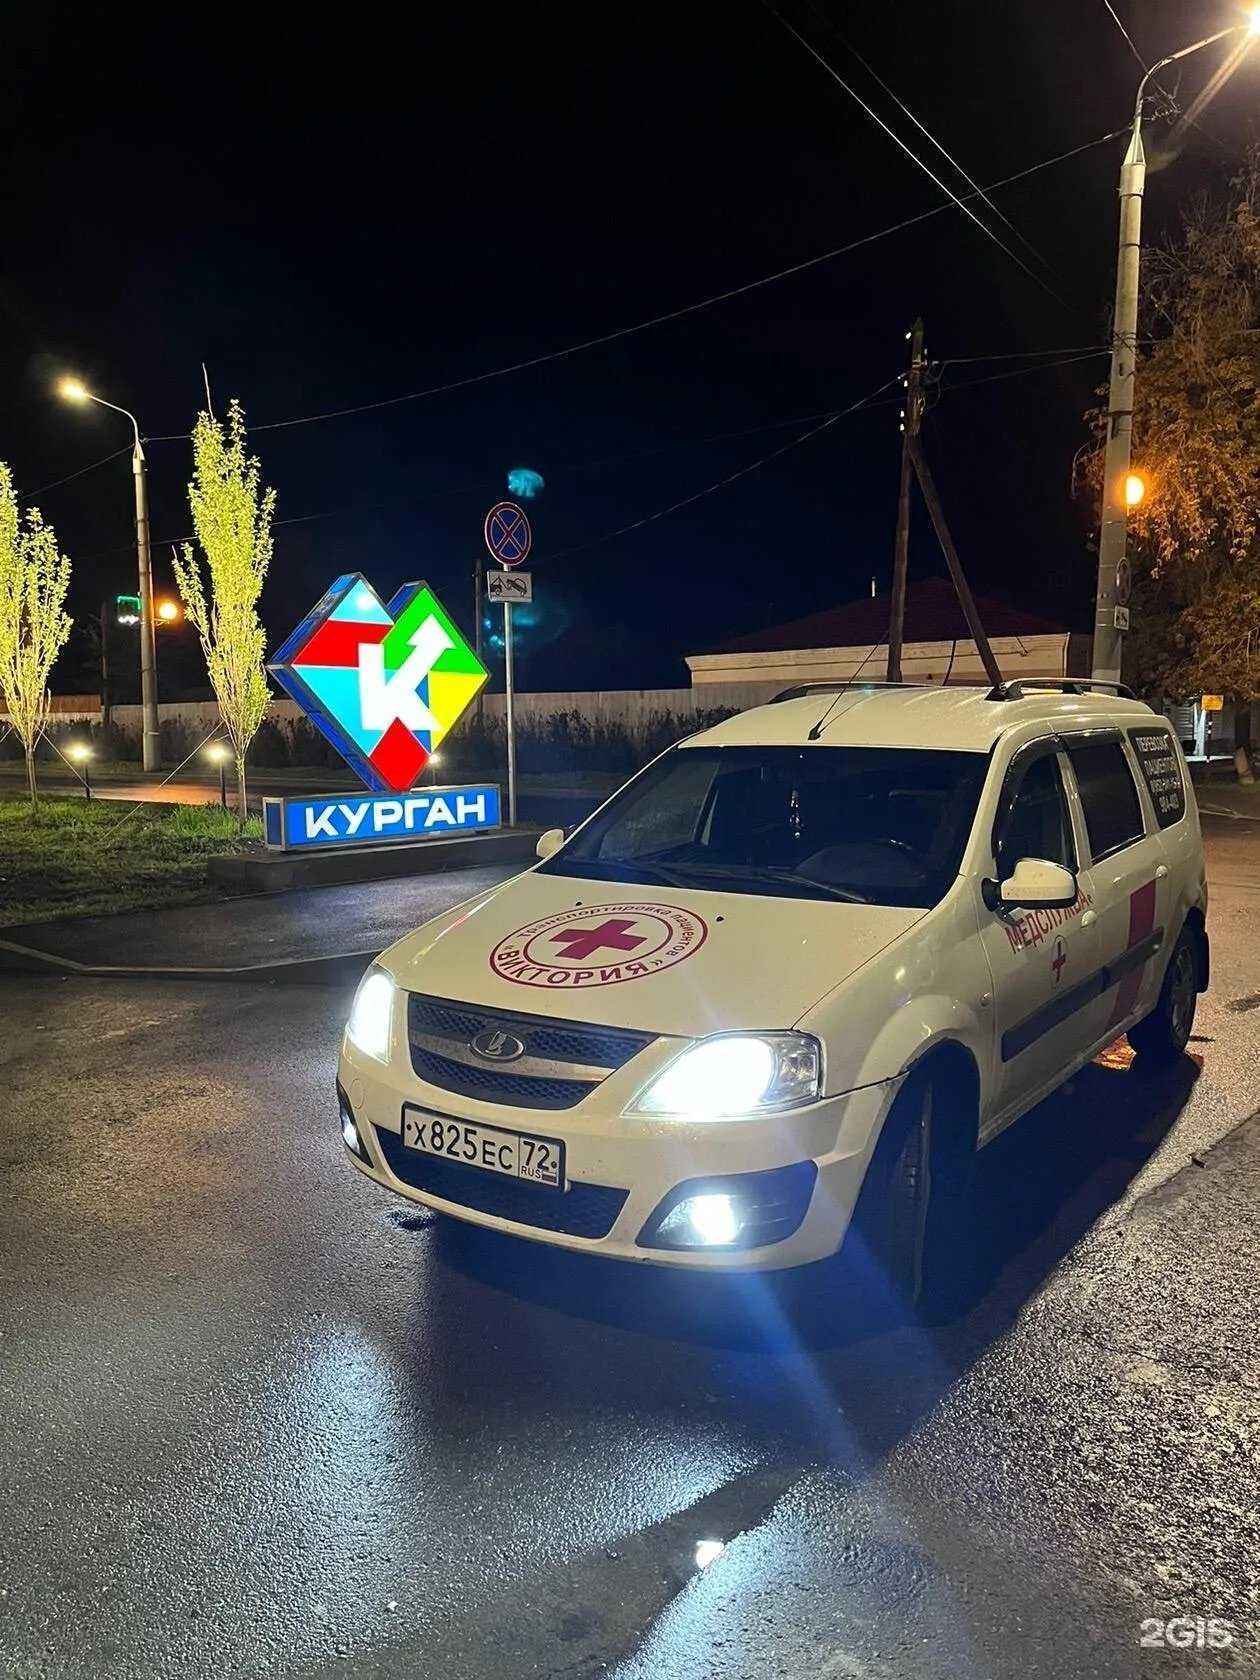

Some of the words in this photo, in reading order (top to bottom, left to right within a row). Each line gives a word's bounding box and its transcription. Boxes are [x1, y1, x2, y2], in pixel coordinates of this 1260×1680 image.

[305, 794, 486, 838] КУРГАН
[522, 1140, 550, 1171] 72
[520, 1165, 541, 1179] RUS
